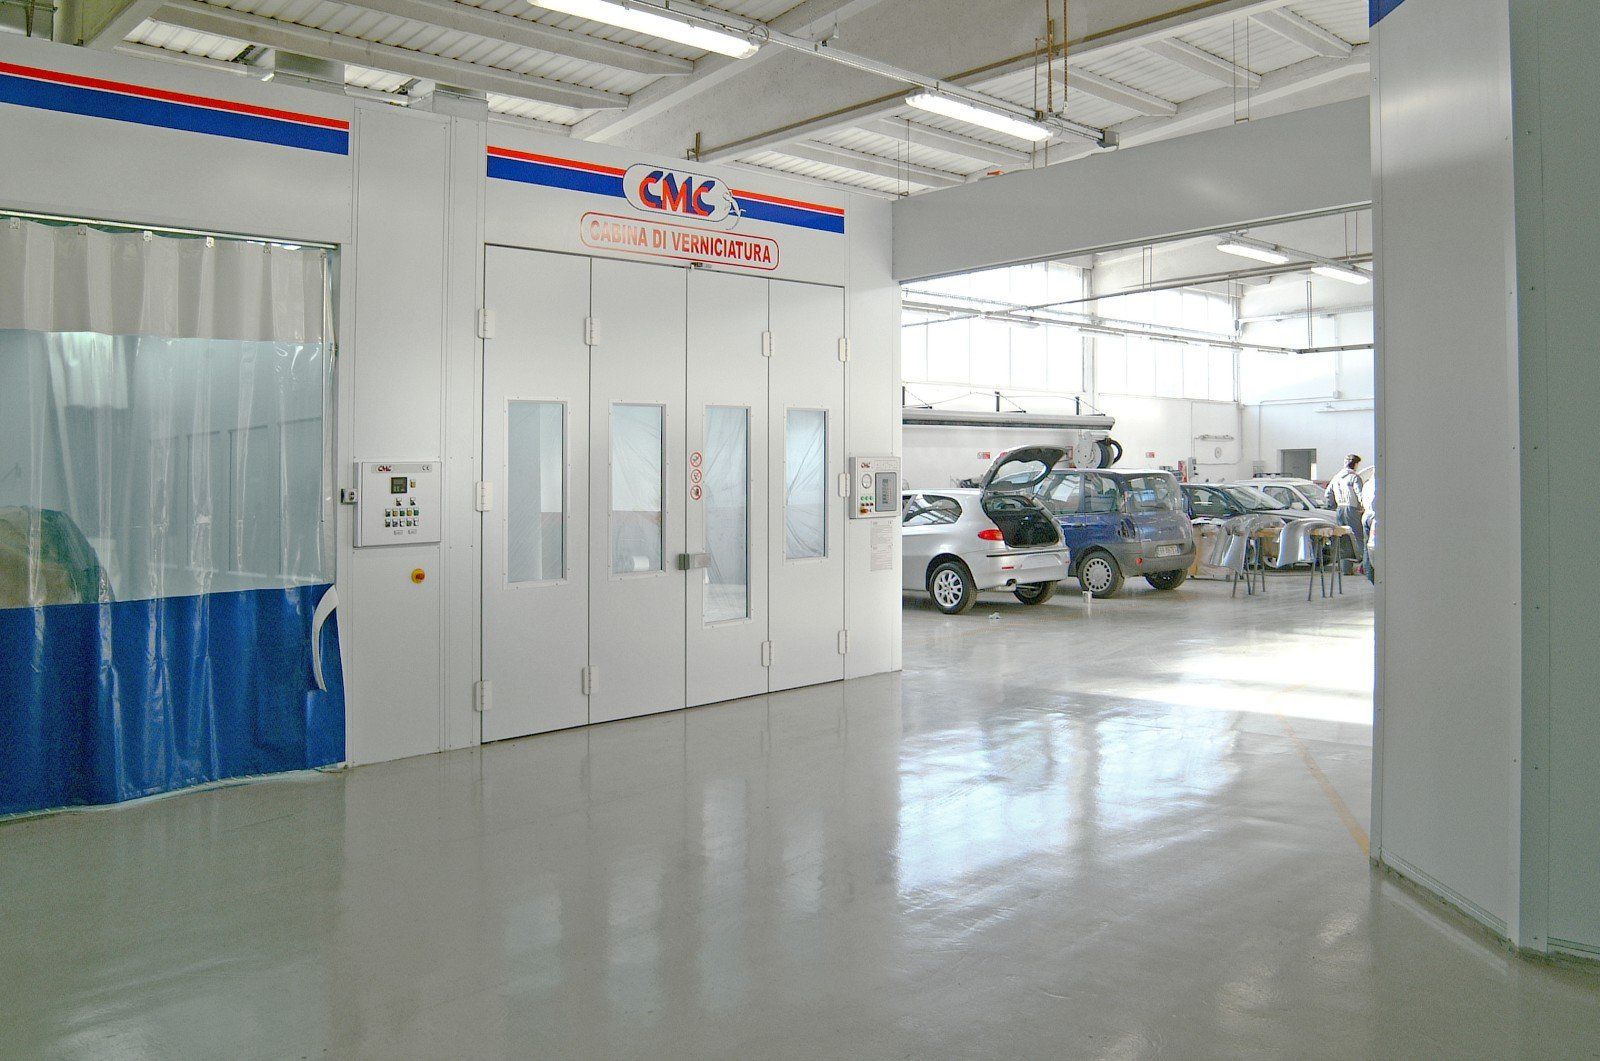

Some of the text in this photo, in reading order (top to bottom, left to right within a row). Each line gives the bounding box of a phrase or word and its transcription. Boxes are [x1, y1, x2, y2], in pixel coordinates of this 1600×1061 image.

[638, 170, 716, 217] CMC
[589, 219, 771, 263] CABINA DI VERNICIATURA
